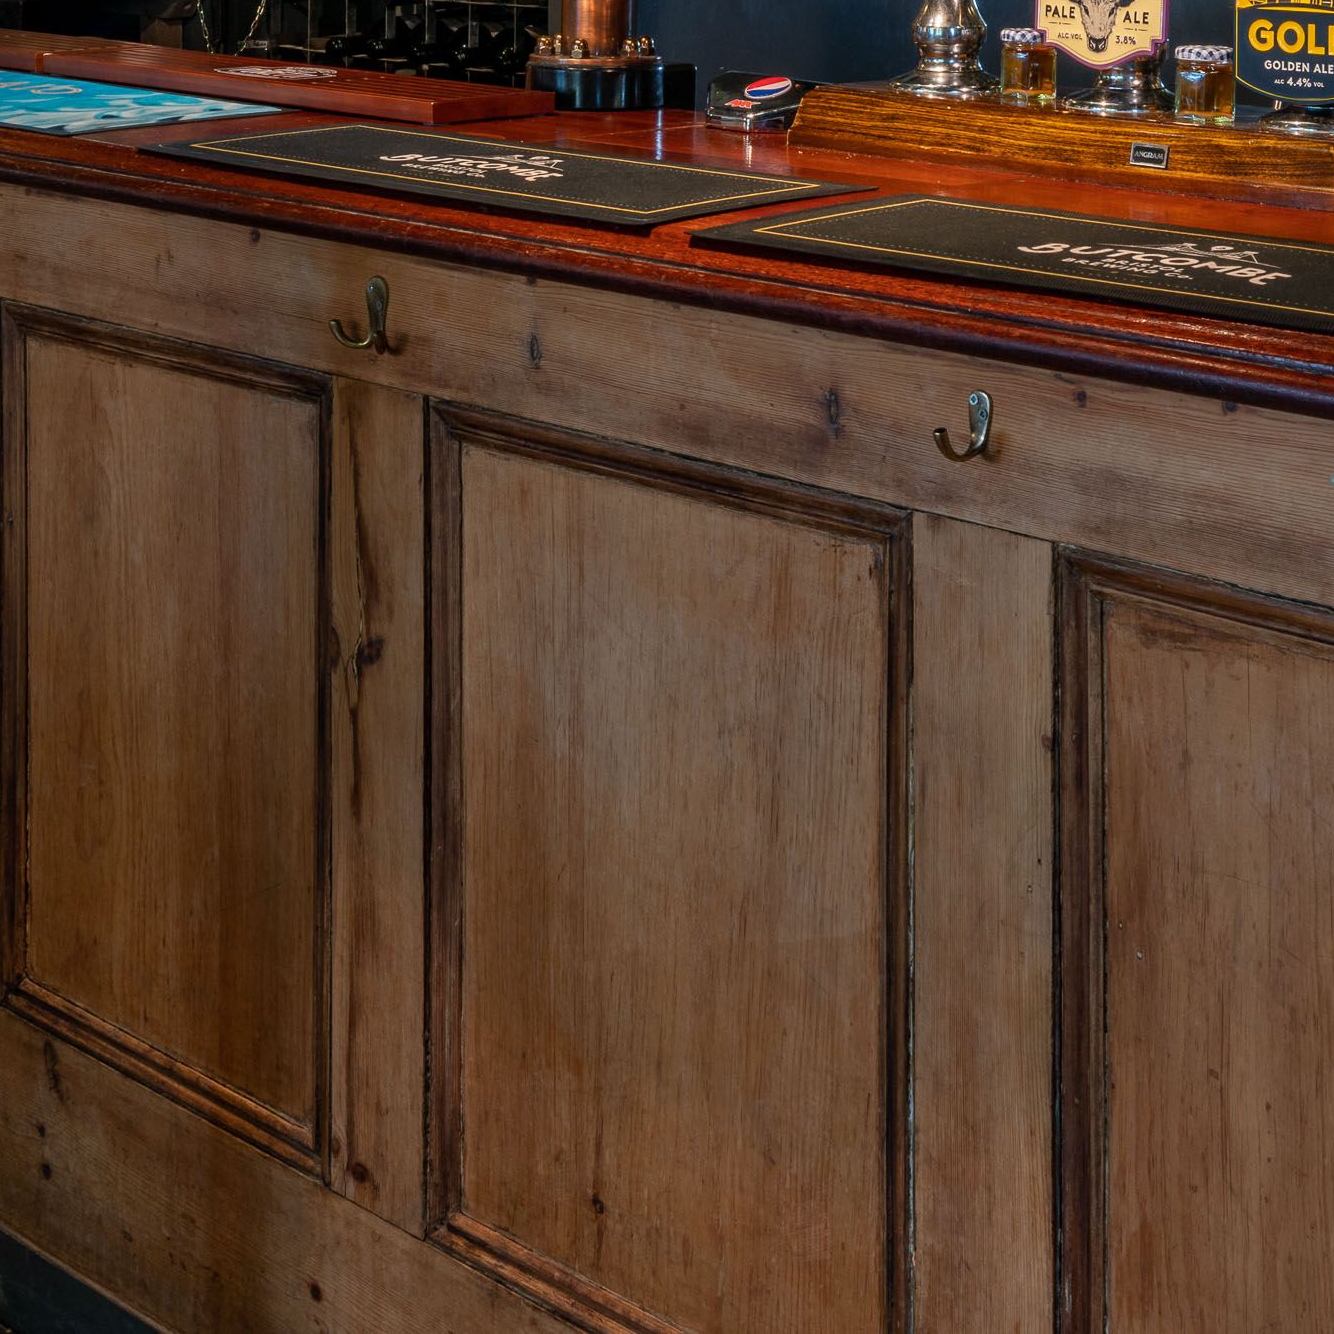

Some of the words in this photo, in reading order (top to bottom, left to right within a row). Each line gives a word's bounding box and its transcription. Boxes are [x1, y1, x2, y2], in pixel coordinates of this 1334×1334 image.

[1044, 4, 1076, 19] PALE
[1122, 11, 1150, 25] ALE
[1070, 32, 1083, 41] VOL
[1115, 36, 1137, 46] 3.8%
[1264, 59, 1310, 74] GOLDEN
[1313, 61, 1334, 75] ALE
[1286, 77, 1312, 88] 4.4%
[1134, 150, 1164, 160] ANGRAM
[379, 153, 564, 182] BUTCOMBE
[1017, 242, 1292, 285] BUTCOMBE
[1061, 257, 1159, 277] BREWING
[1101, 257, 1184, 274] BRISTOL
